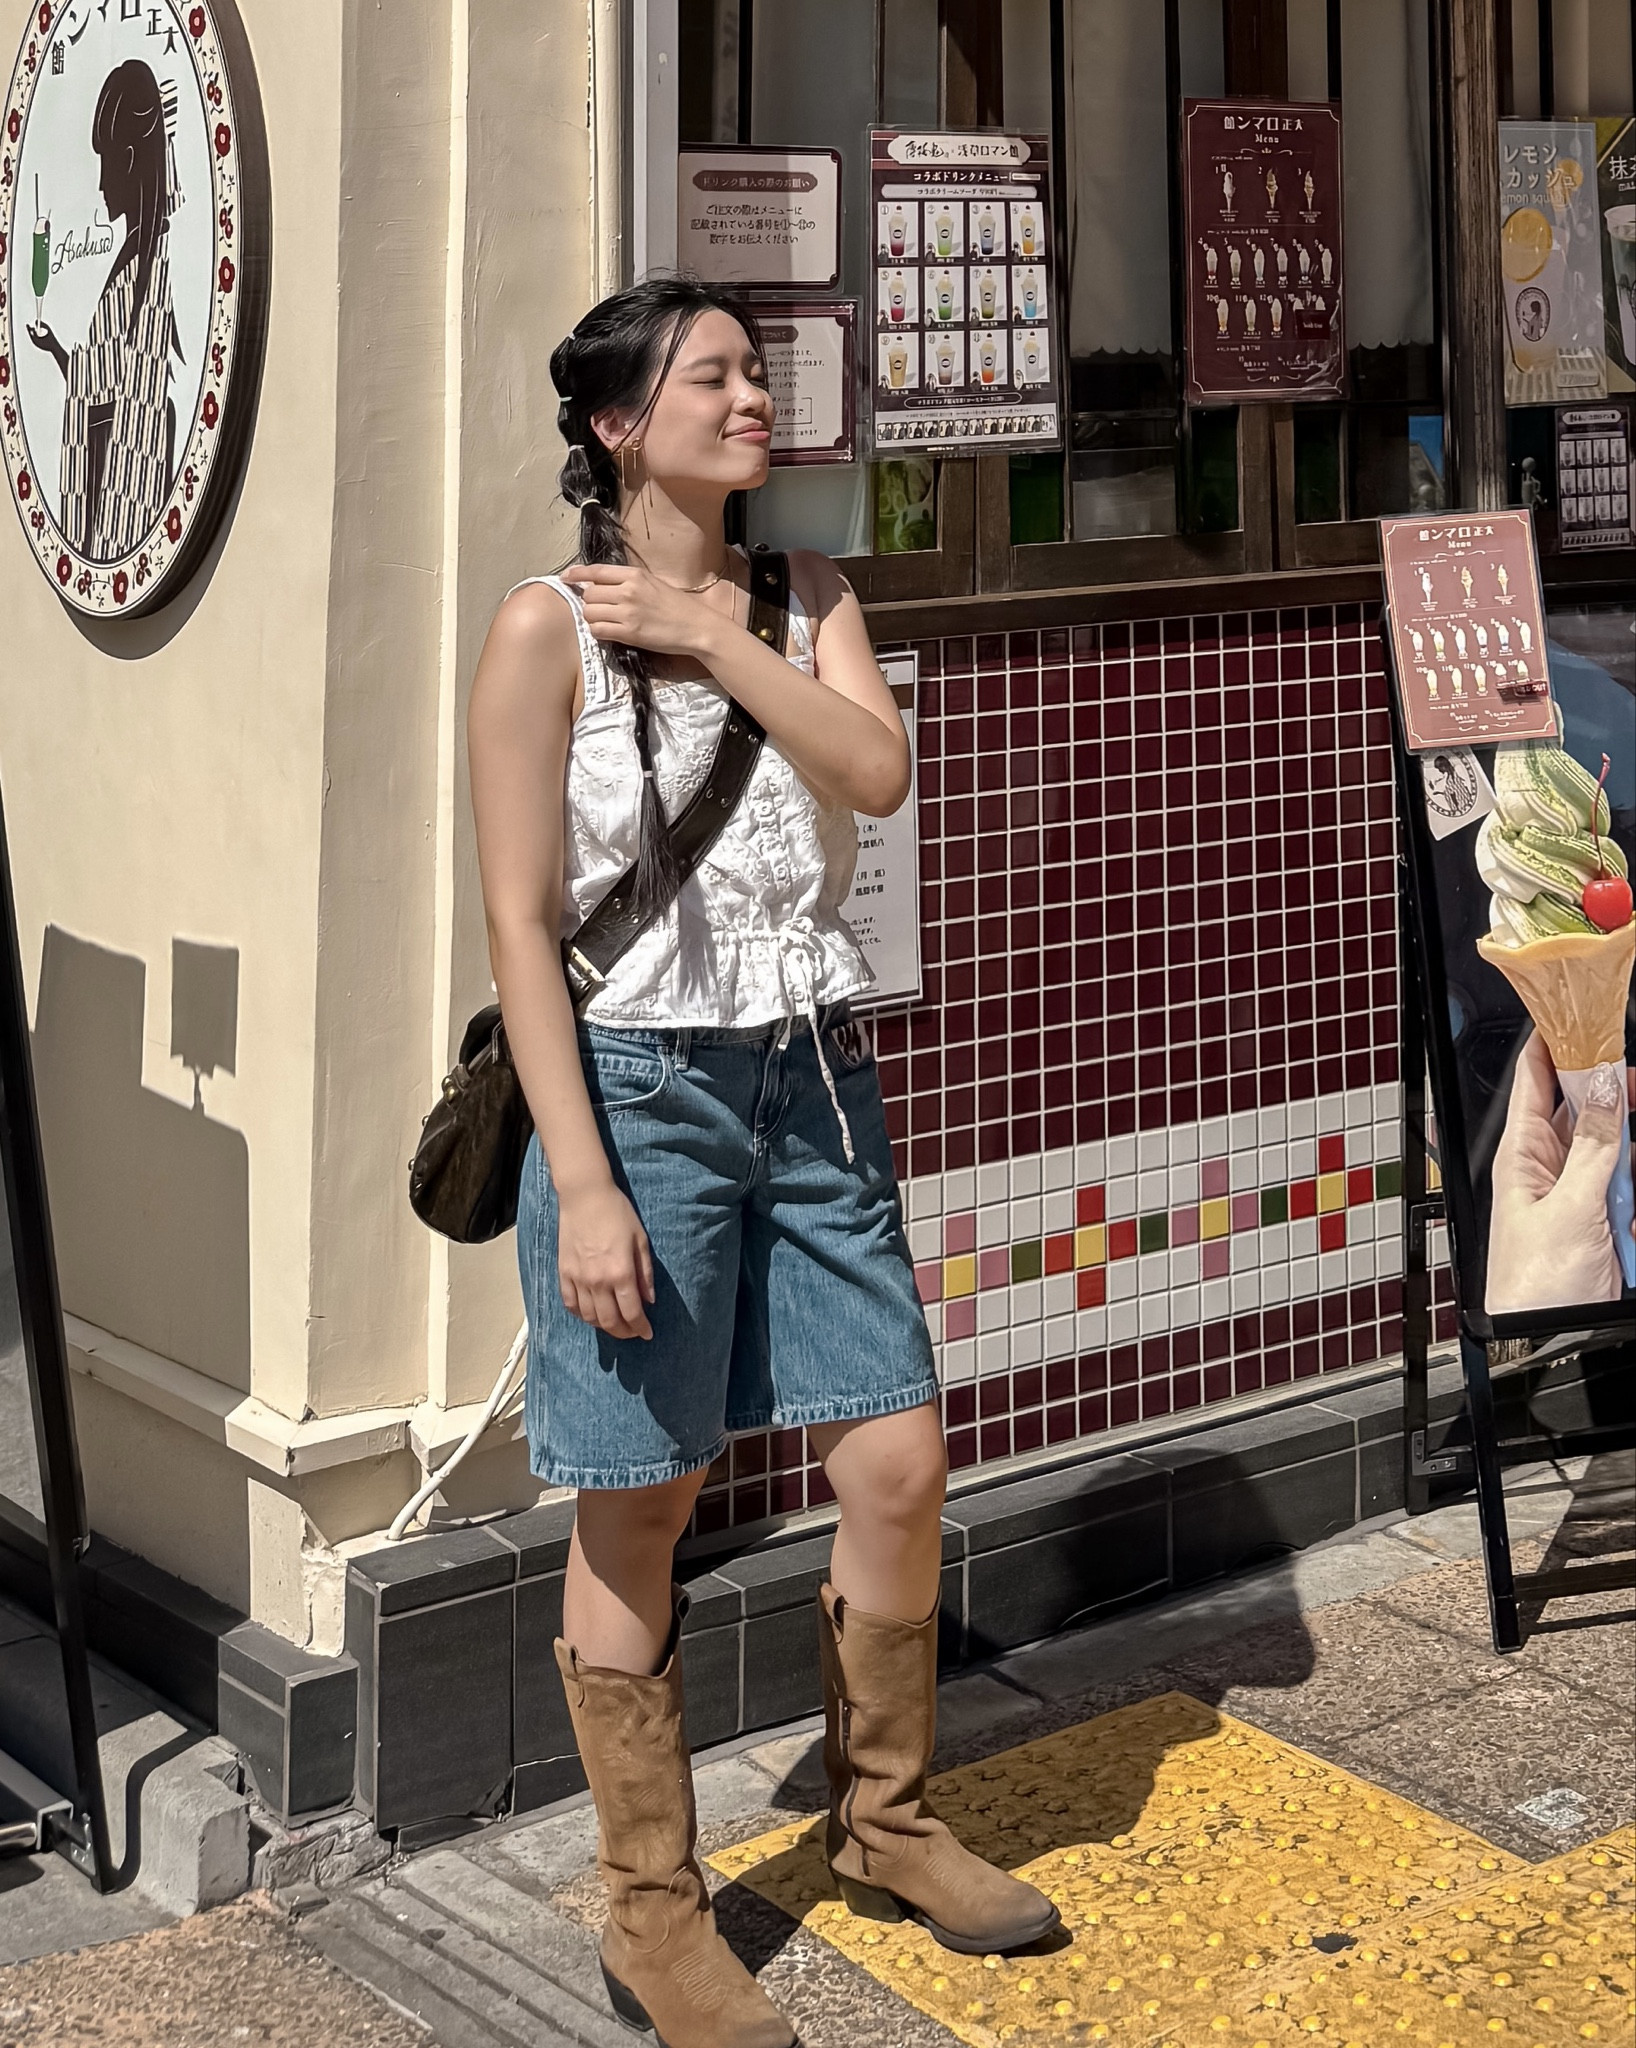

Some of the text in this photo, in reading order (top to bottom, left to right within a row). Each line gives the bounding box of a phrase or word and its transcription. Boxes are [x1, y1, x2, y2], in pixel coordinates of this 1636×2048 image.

[1255, 134, 1279, 143] Menu
[1504, 145, 1557, 164] レモン
[913, 171, 1008, 182] コラボドリンクメニュー
[1500, 167, 1576, 189] カッシュ
[51, 209, 114, 274] Asakusa
[709, 233, 799, 245] 数字をお伝えください
